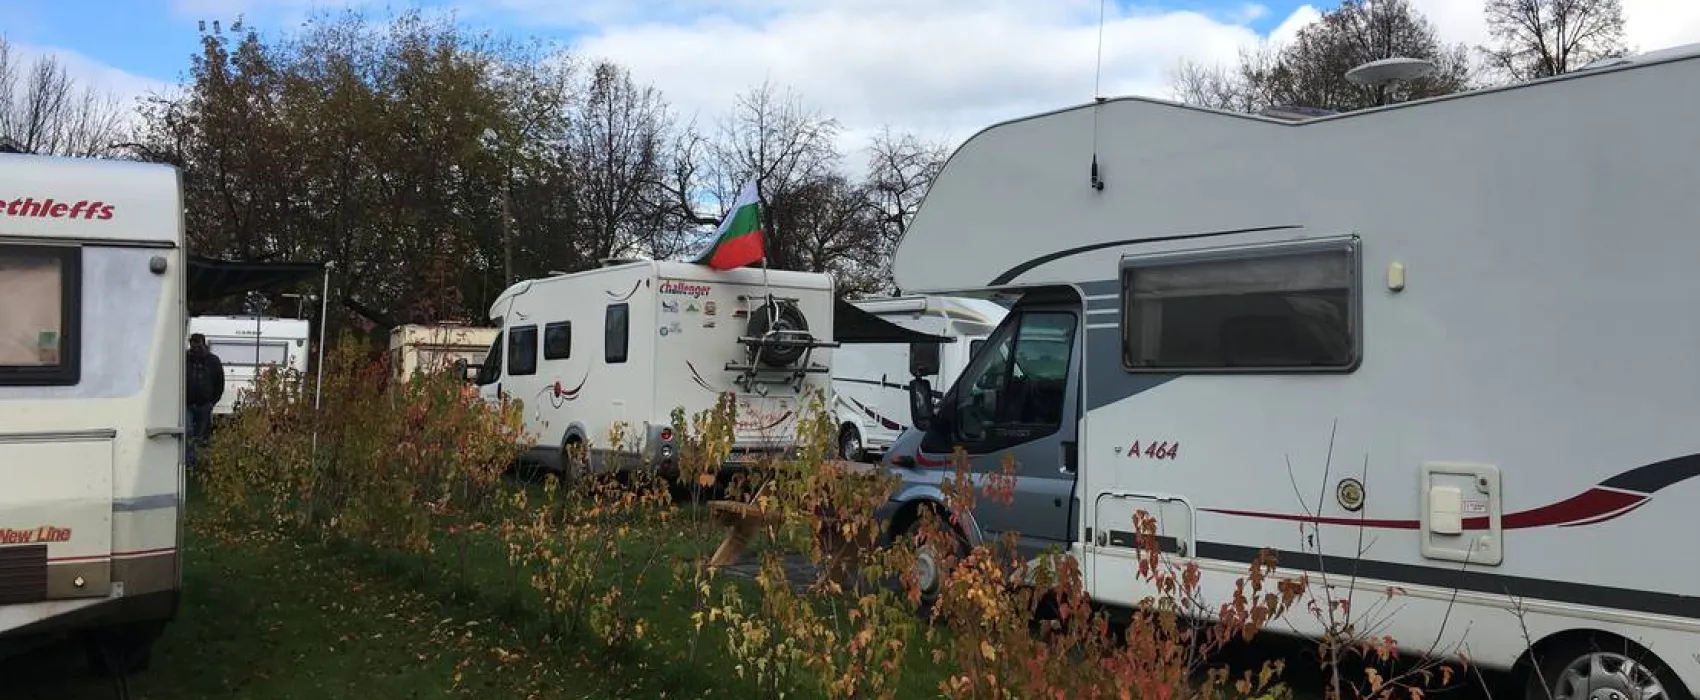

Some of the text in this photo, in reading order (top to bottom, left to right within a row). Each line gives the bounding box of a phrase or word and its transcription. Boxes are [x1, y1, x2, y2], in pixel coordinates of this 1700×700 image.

[1127, 440, 1179, 460] A 464
[0, 525, 72, 544] New Line
